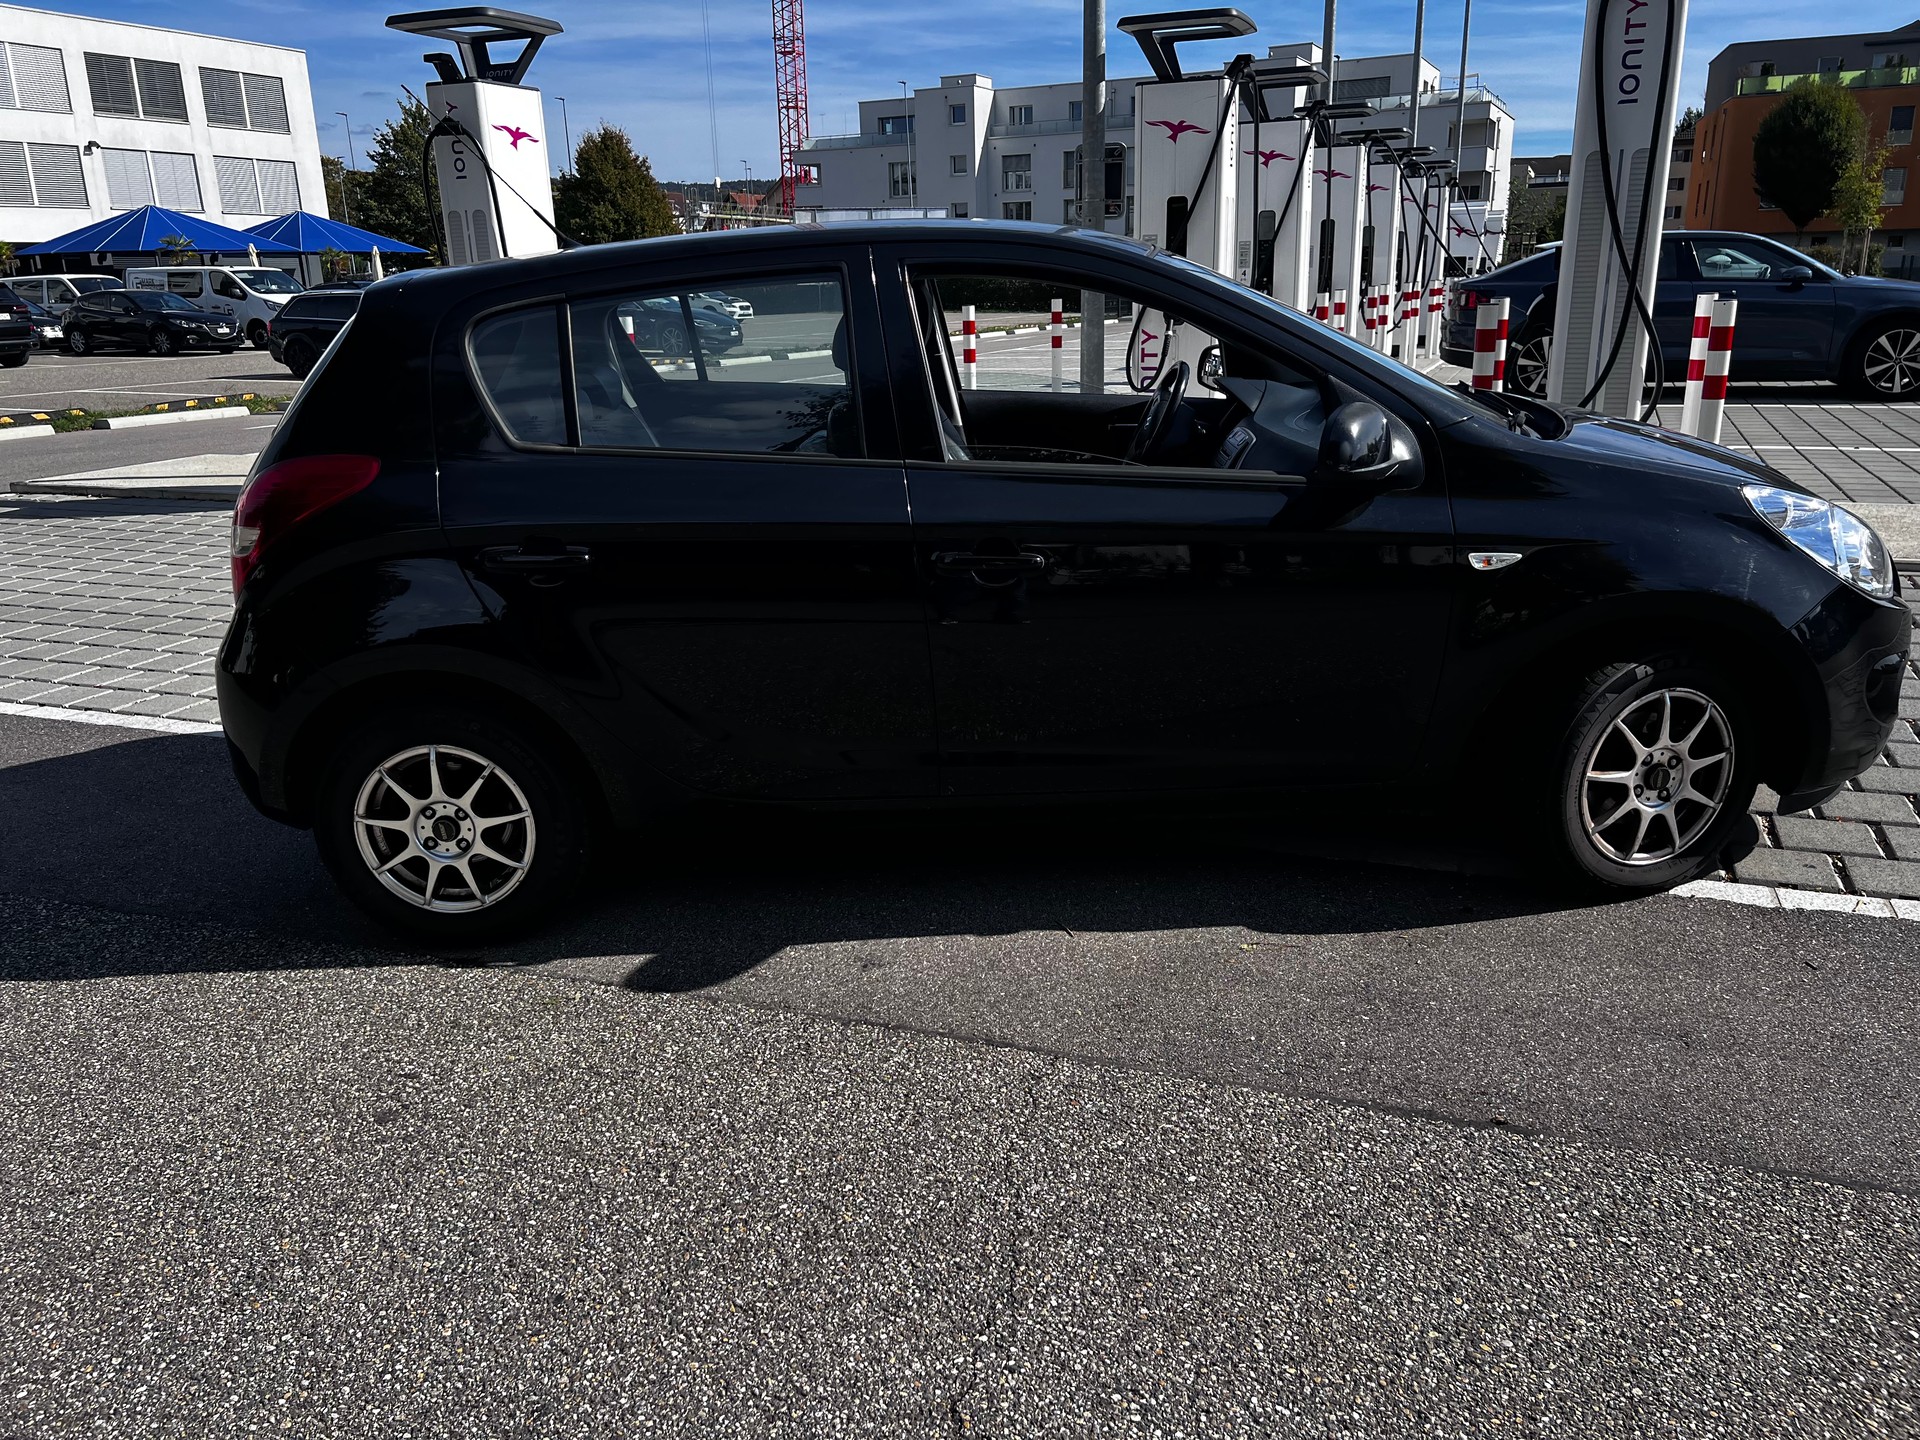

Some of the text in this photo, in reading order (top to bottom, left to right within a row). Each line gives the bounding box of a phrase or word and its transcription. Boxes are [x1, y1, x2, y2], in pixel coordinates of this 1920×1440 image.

[486, 69, 514, 78] IONITY
[1617, 0, 1649, 105] IONITY
[446, 101, 467, 180] IONY
